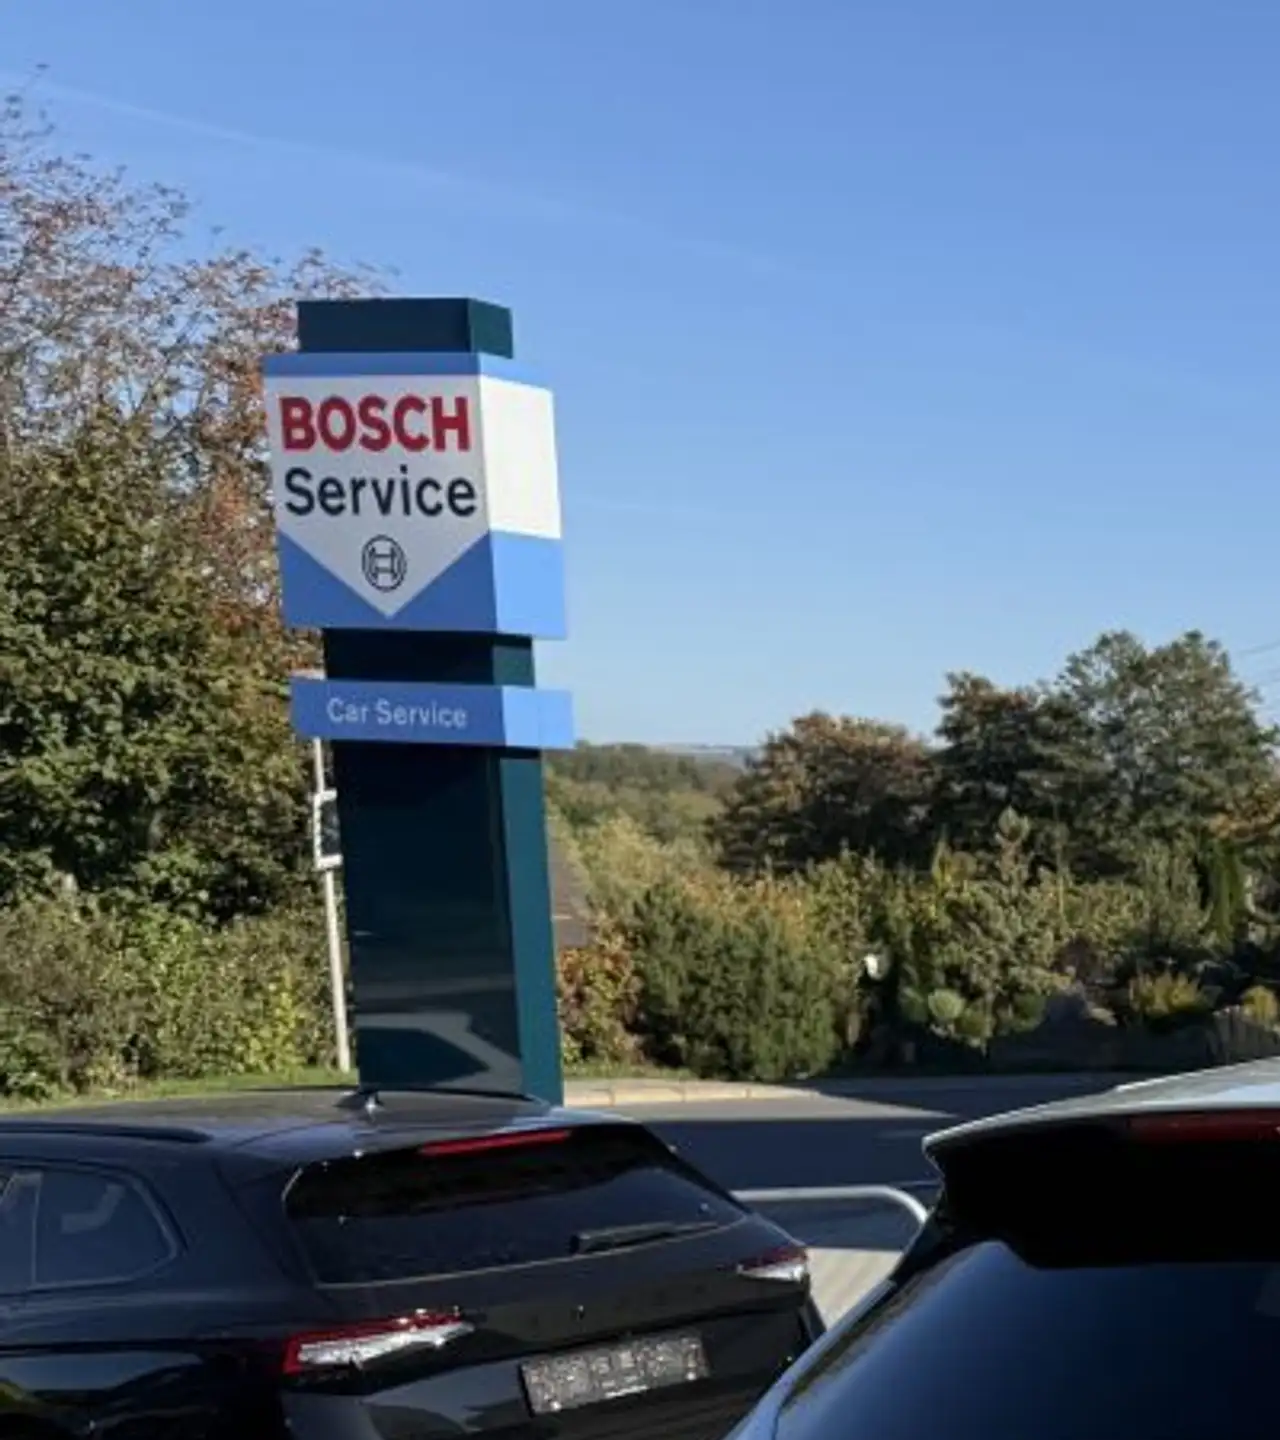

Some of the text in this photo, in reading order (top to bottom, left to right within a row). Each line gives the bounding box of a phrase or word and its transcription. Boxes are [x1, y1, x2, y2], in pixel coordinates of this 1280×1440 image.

[279, 395, 472, 453] BOSCH
[284, 465, 477, 517] Service
[326, 697, 468, 730] Car Service
